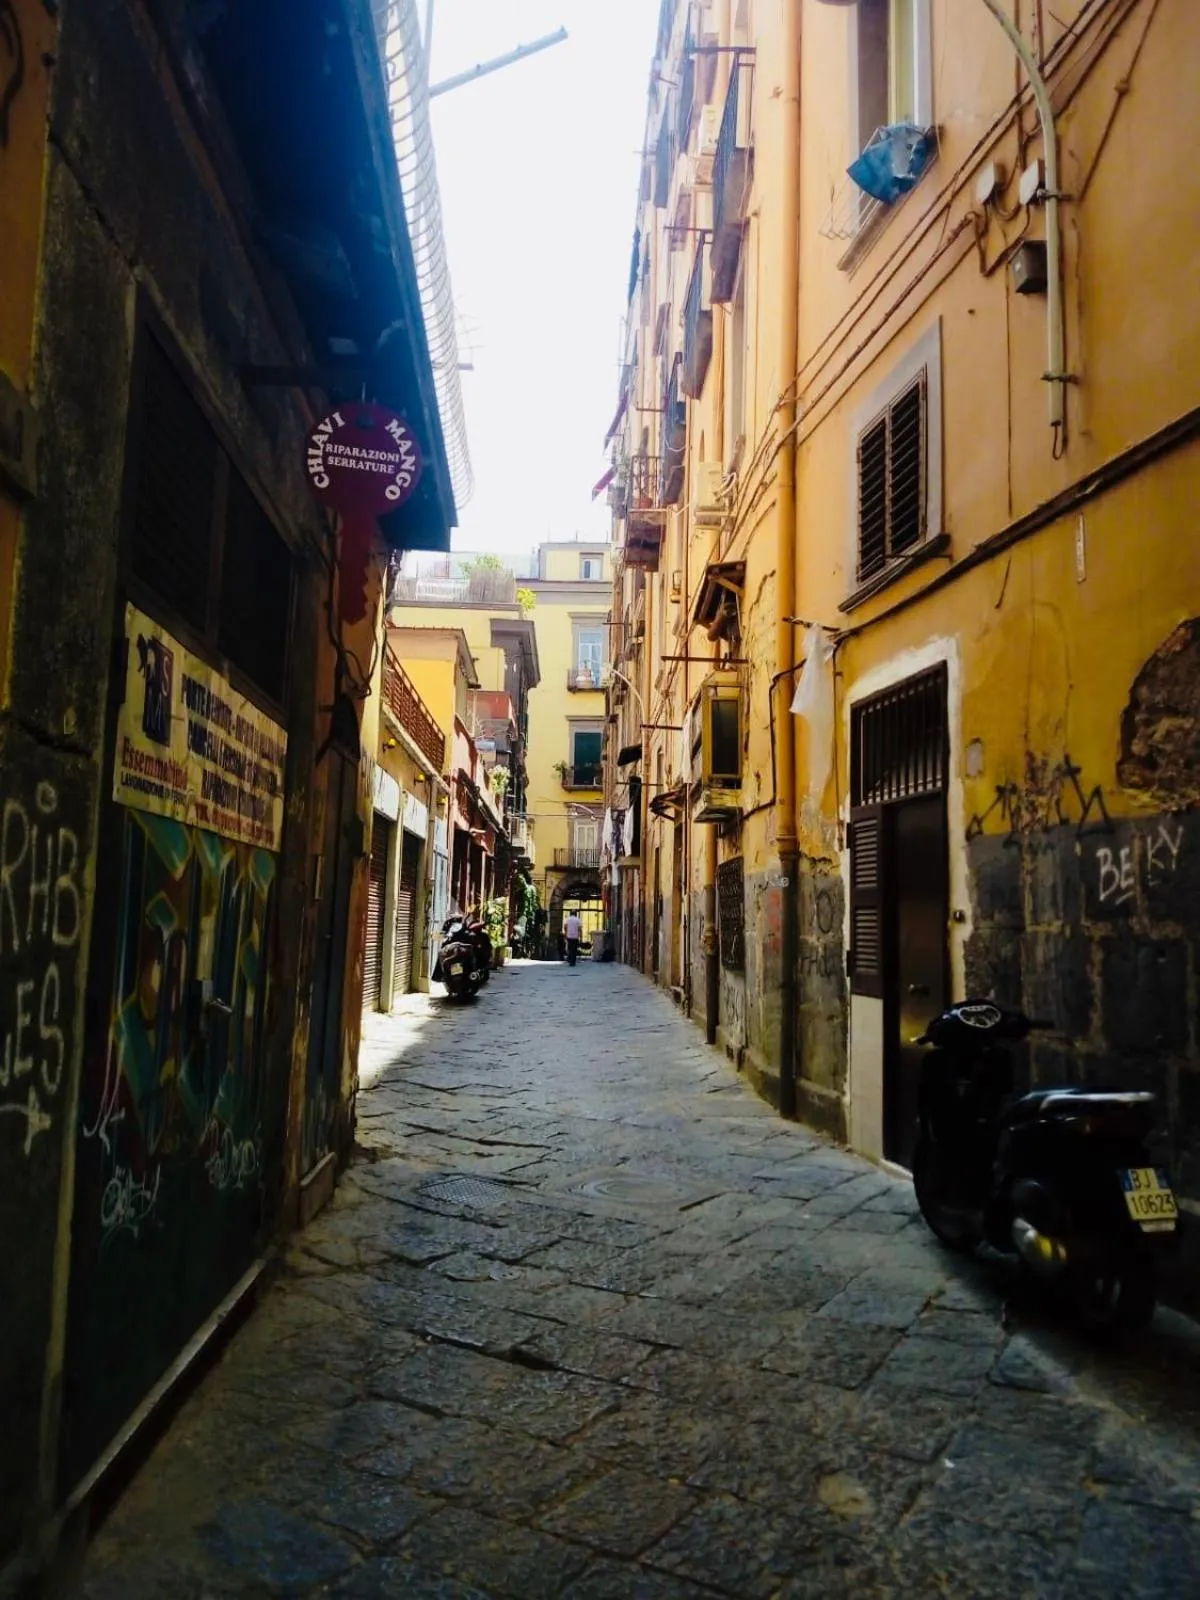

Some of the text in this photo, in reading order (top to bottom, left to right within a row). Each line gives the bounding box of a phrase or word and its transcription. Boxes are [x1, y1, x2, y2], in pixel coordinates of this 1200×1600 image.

[307, 411, 346, 489] CHIAVI
[325, 443, 400, 464] RIPARAZIONI
[384, 418, 416, 501] MANGO
[327, 455, 396, 475] SERRATURE
[1131, 1193, 1176, 1215] 10623
